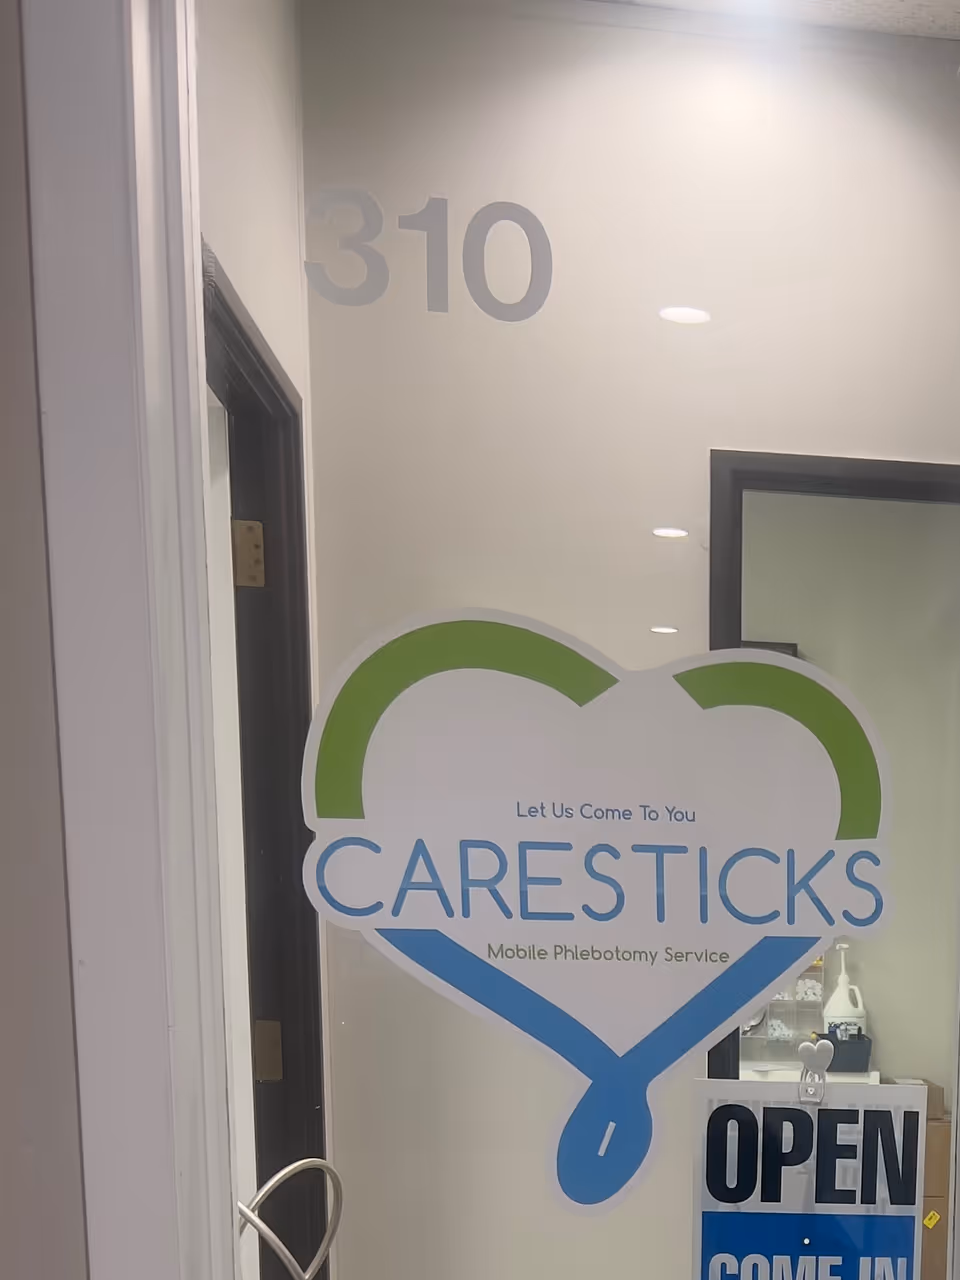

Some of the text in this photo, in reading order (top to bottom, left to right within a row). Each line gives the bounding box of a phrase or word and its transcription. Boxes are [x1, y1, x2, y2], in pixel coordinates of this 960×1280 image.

[303, 188, 553, 322] 310
[516, 801, 696, 823] Let Us Come To You
[315, 836, 885, 927] CARESTICKS
[487, 943, 730, 966] Mobile Phlebotomy Service
[705, 1103, 920, 1206] OPEN
